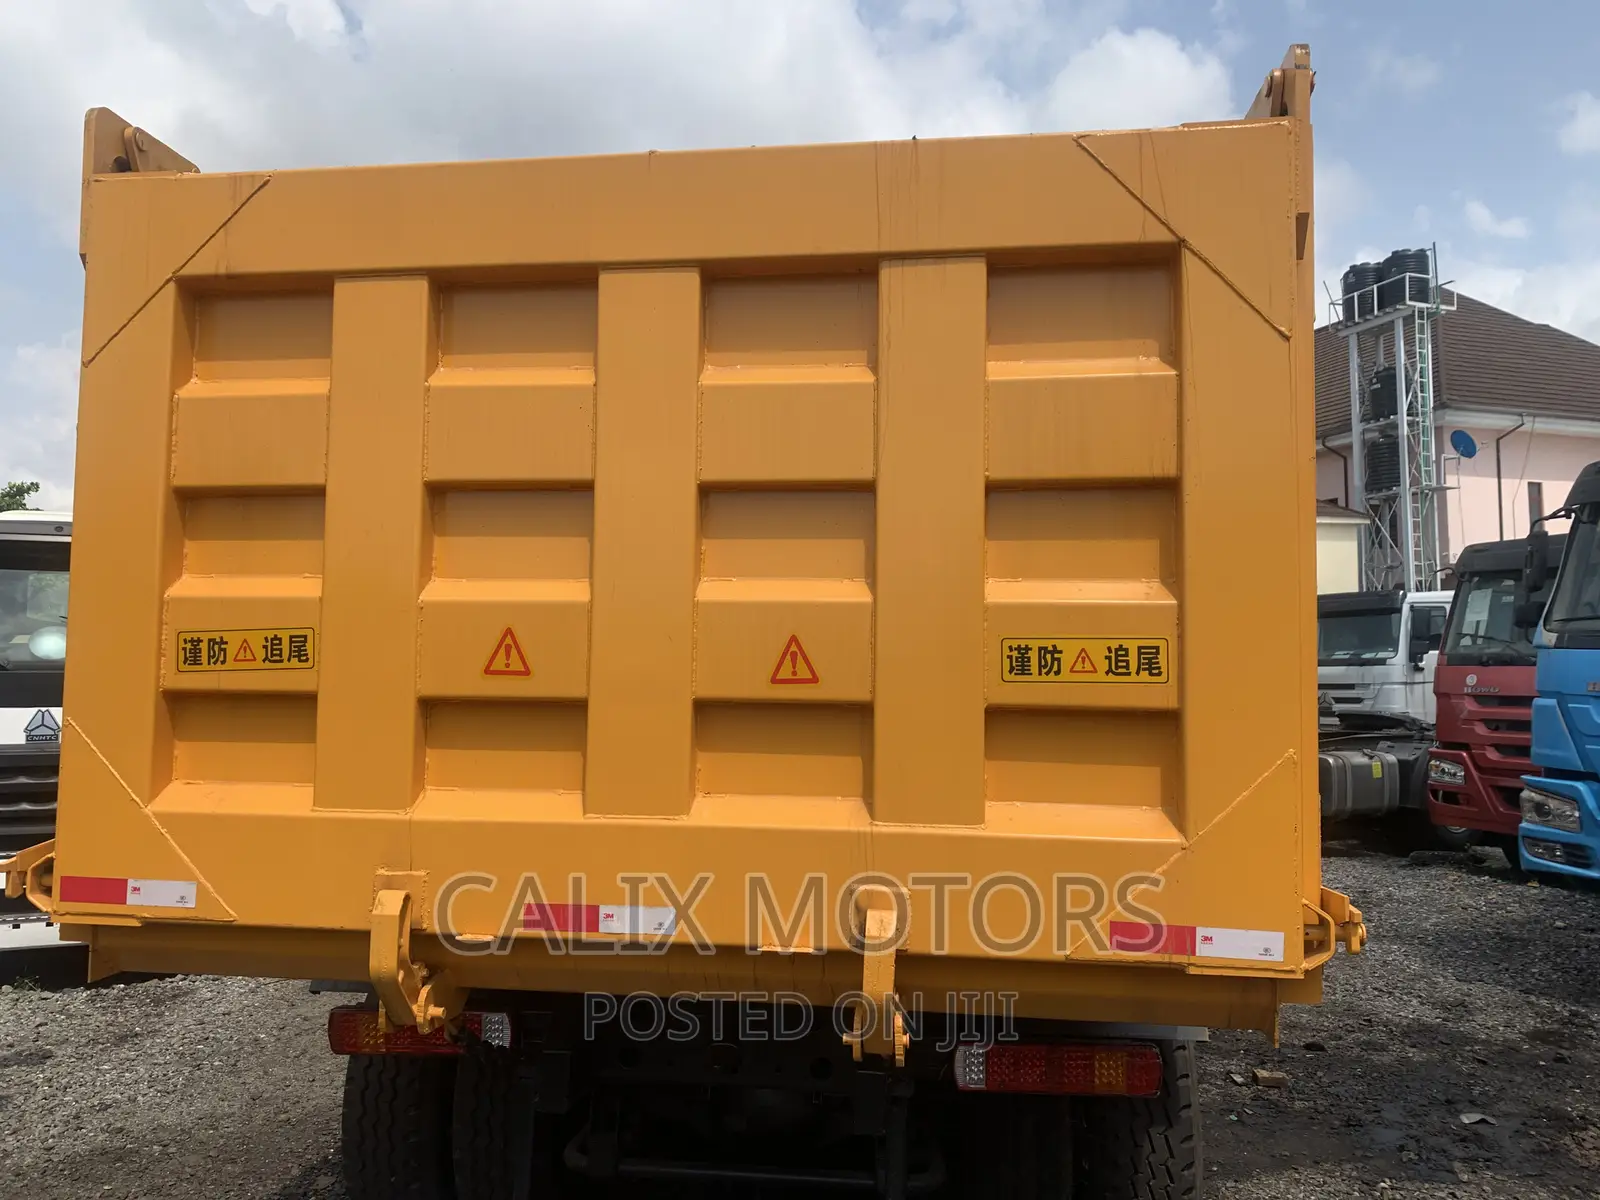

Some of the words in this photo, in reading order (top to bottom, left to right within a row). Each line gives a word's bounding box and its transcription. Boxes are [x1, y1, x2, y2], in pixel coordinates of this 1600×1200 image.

[182, 636, 228, 665] 谨防
[262, 634, 309, 663] 追尾
[1006, 644, 1063, 676] 谨防
[1104, 644, 1163, 676] 追尾
